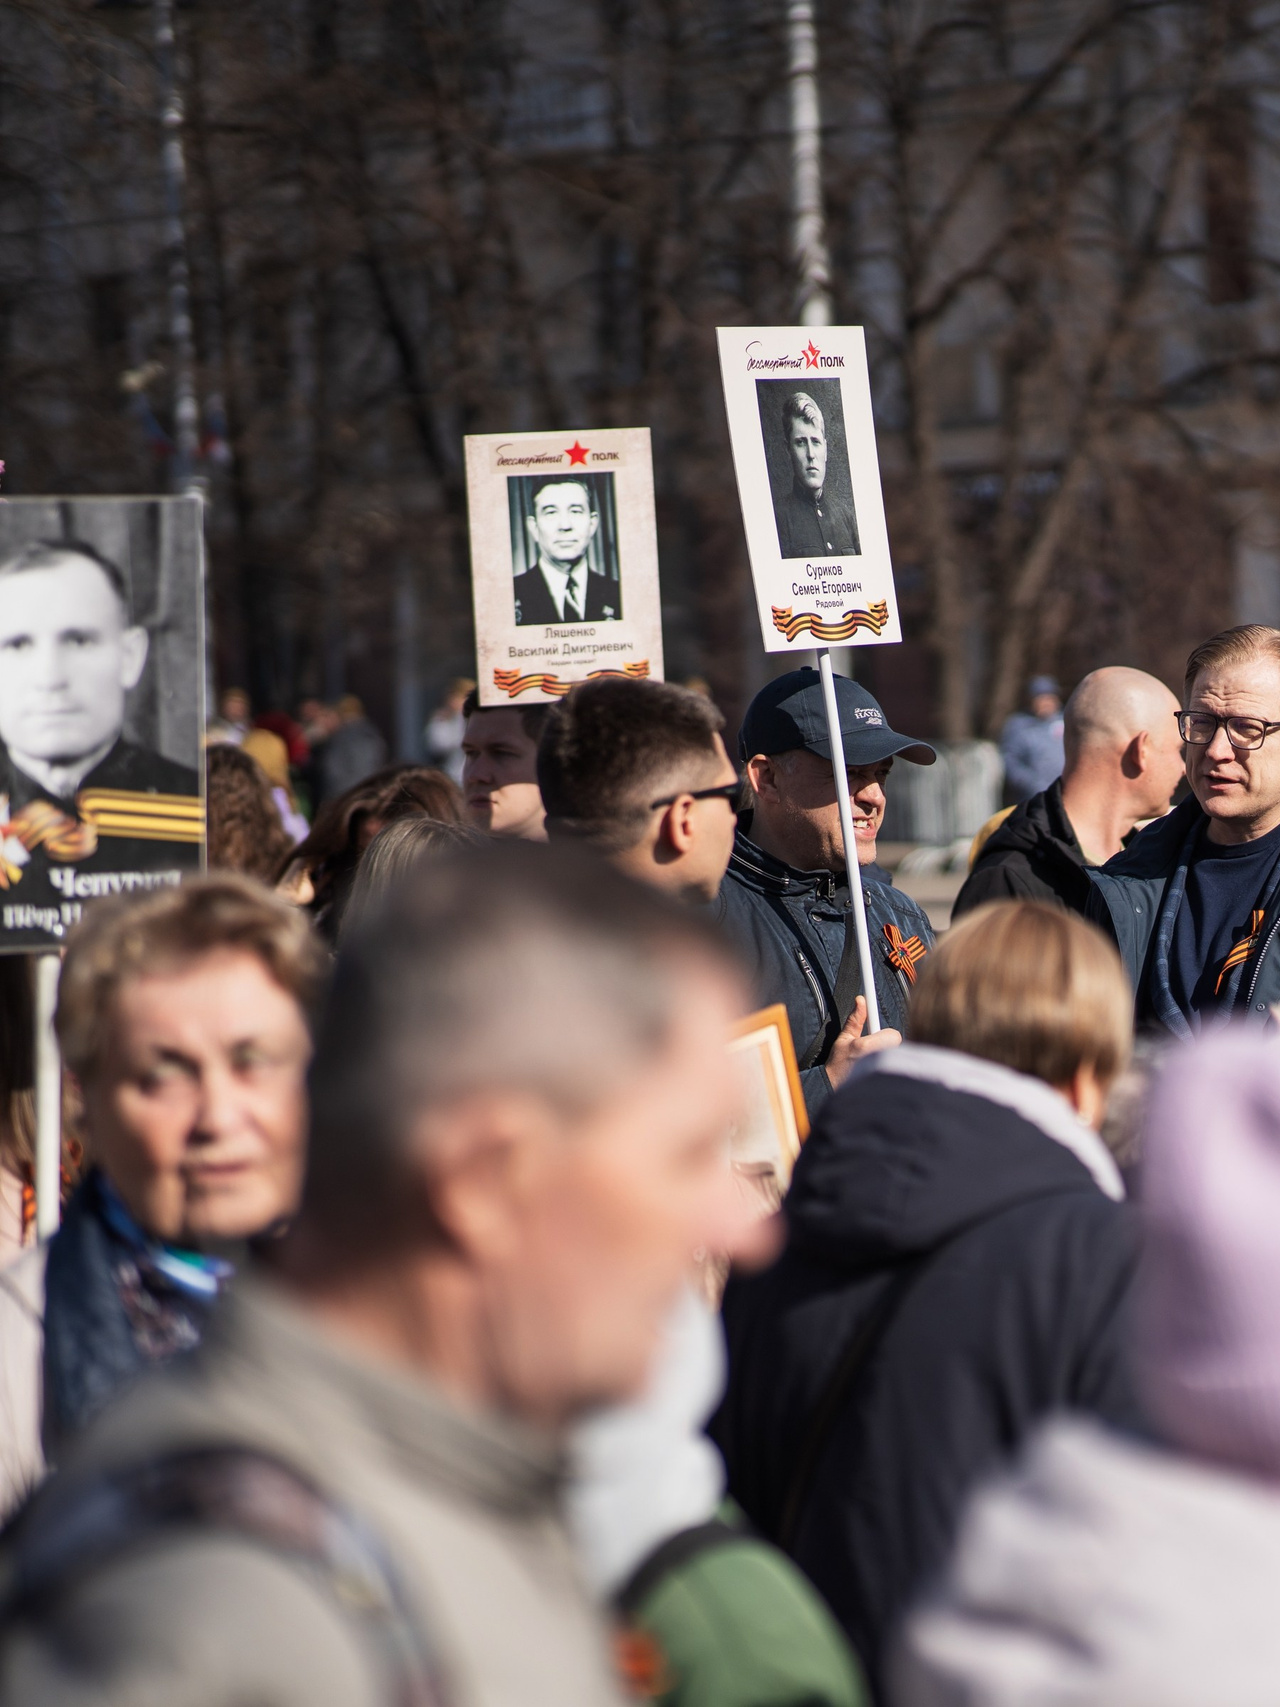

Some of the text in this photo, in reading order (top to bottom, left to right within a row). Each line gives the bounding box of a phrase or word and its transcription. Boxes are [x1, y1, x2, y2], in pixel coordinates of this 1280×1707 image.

[806, 563, 843, 580] Суриков
[792, 580, 862, 596] Семен Егорович
[815, 599, 844, 609] Рядовой
[544, 627, 596, 639] Ляшенко
[508, 641, 634, 658] Василий Дмитриевич
